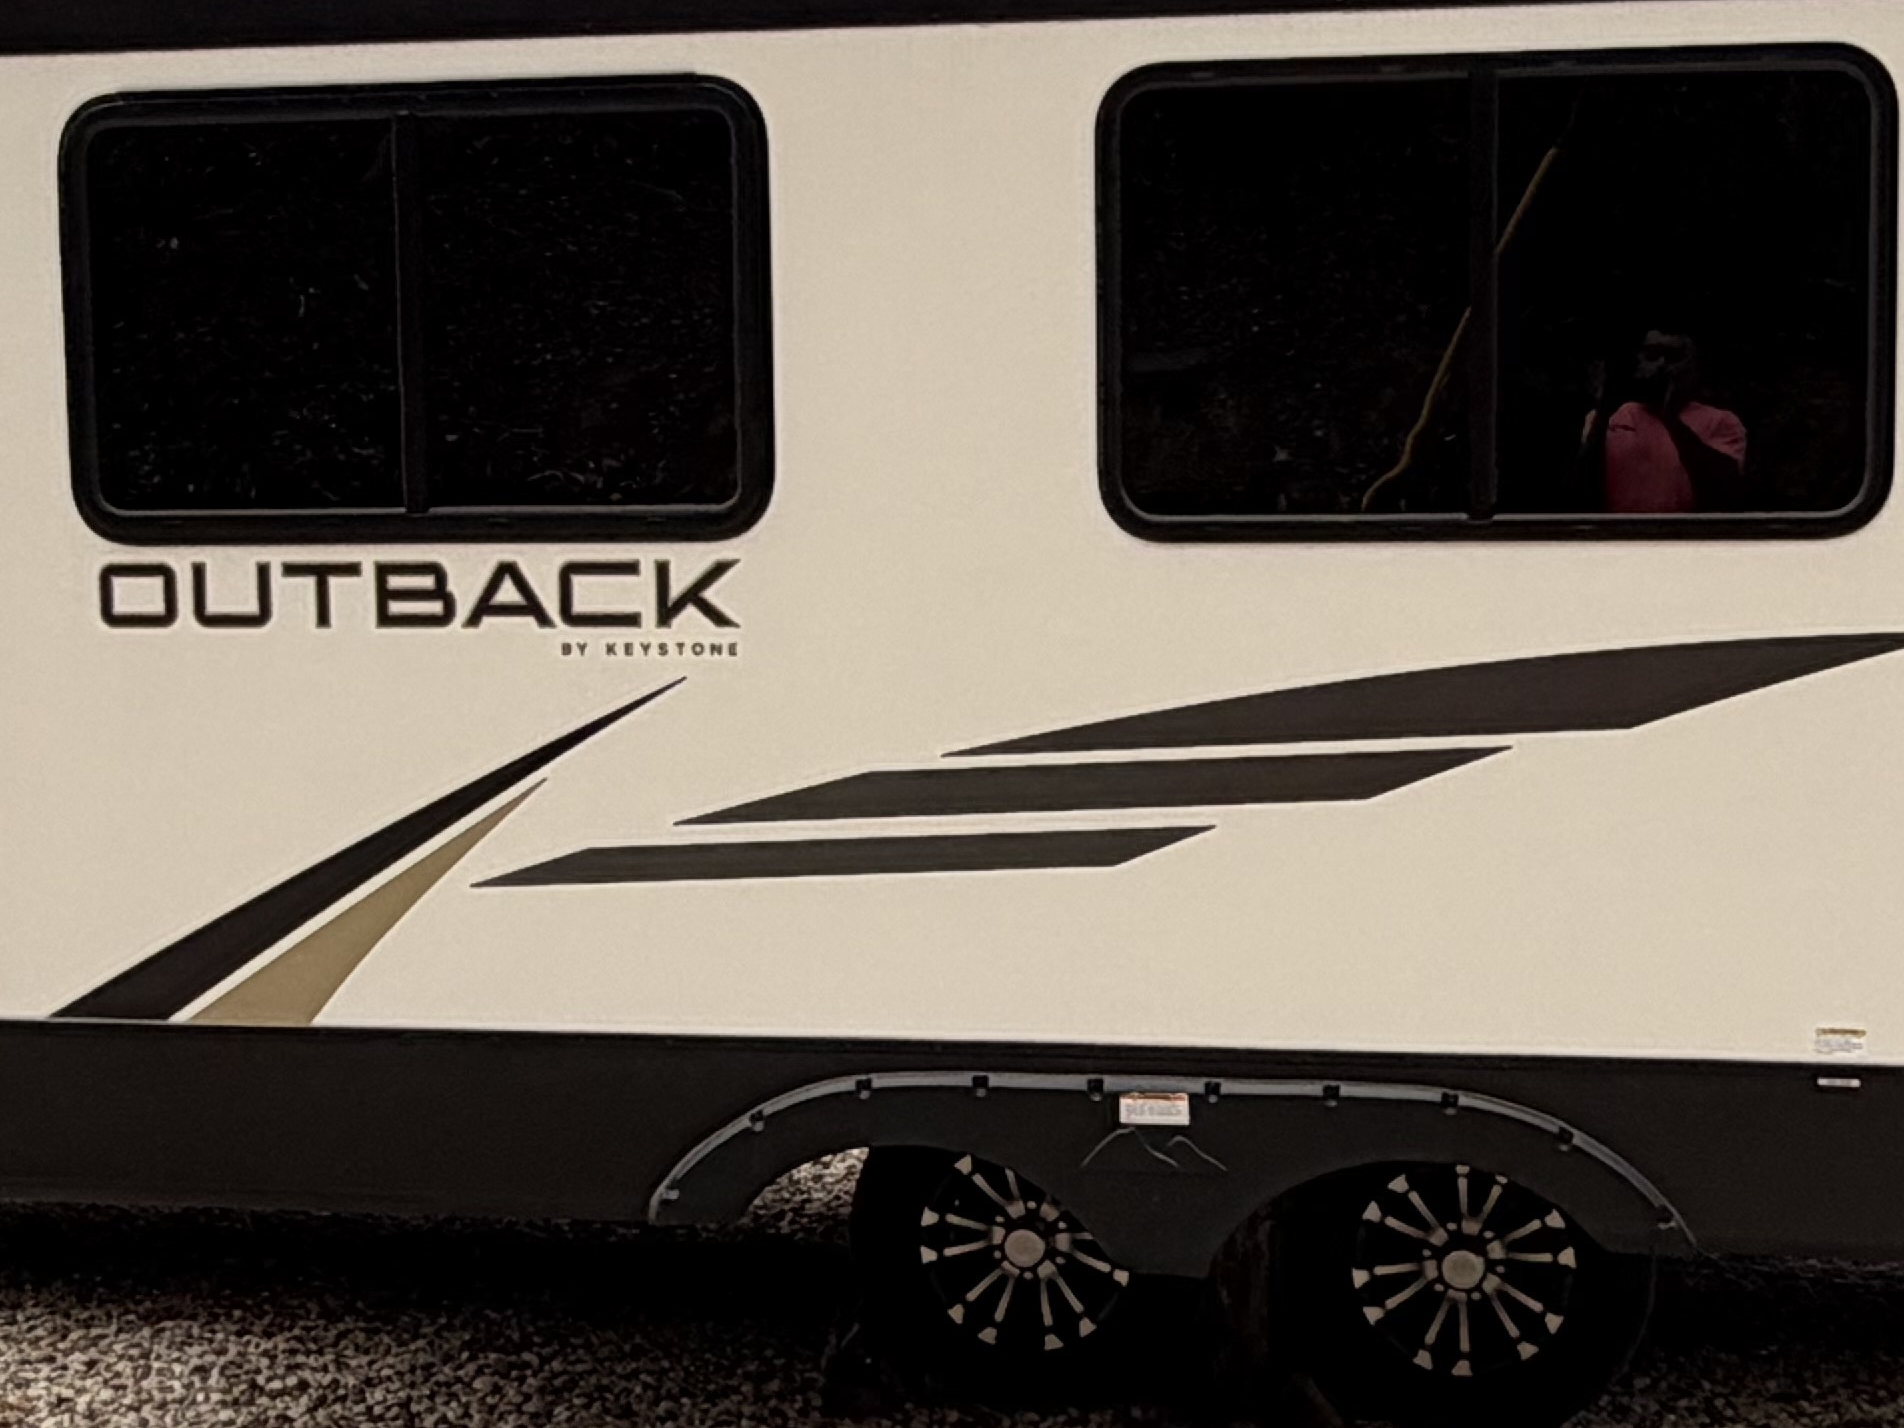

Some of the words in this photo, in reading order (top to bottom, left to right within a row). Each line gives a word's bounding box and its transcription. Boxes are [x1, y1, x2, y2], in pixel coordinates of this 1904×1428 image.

[98, 558, 742, 630] OUTBACK
[560, 641, 588, 657] BY
[604, 641, 739, 657] KEYSTONE
